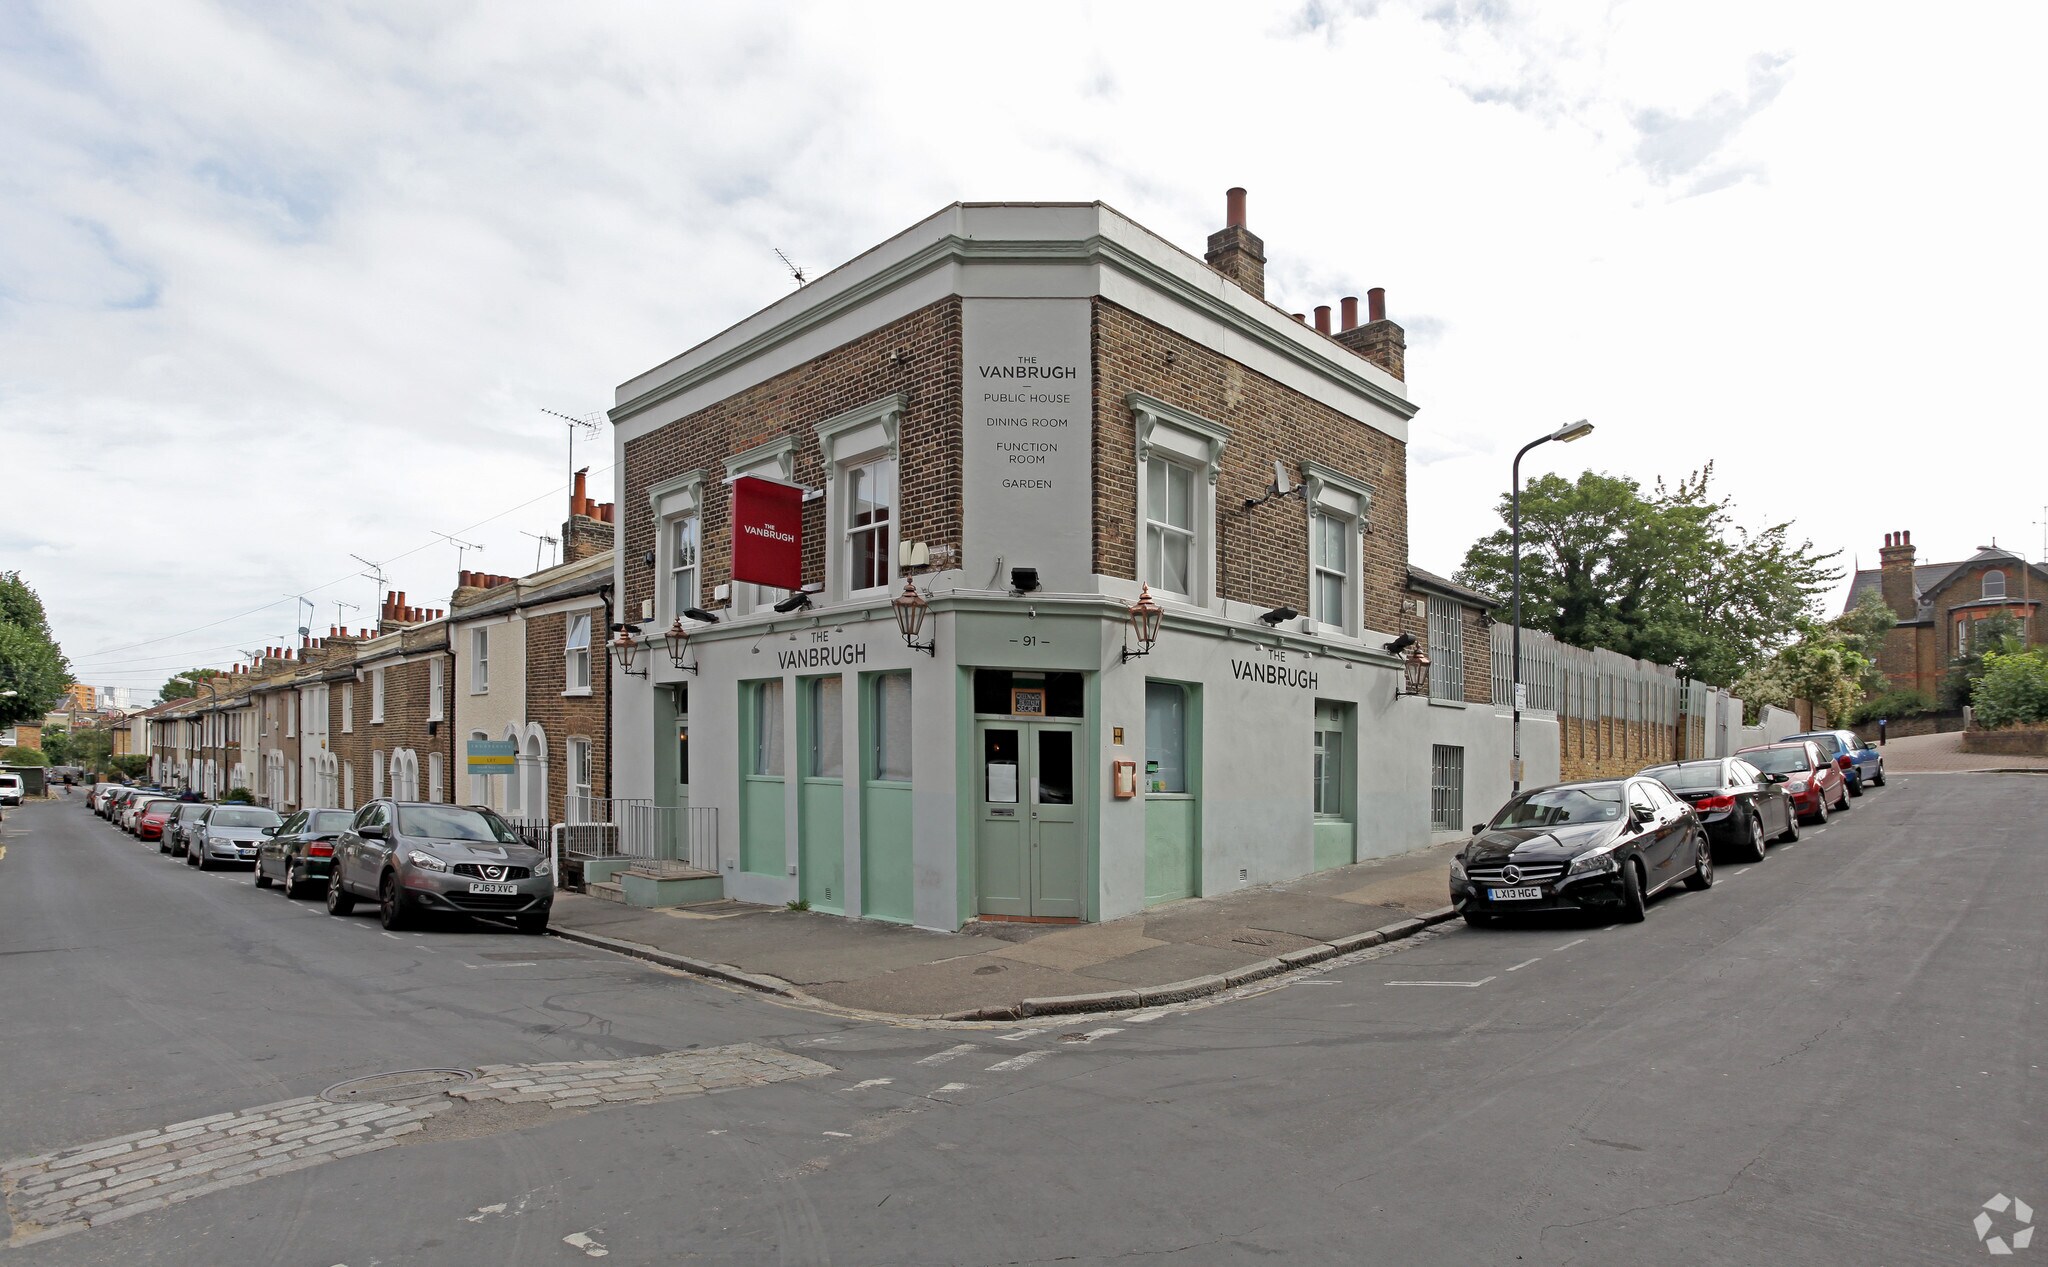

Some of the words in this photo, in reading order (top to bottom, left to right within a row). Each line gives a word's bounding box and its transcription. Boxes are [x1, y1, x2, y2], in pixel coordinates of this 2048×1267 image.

[1018, 356, 1037, 364] THE
[979, 365, 1076, 379] VANBRUGH
[984, 393, 1026, 403] PUBLIC
[1030, 394, 1070, 403] HOUSE
[986, 417, 1028, 427] DINING
[1032, 418, 1068, 427] ROOM
[996, 442, 1058, 452] FUNCTION
[1009, 455, 1045, 464] ROOM
[1002, 479, 1052, 488] GARDEN
[744, 524, 794, 543] VANBRUGH
[811, 630, 829, 643] THE
[778, 643, 866, 670] VANBRUGH
[1268, 649, 1286, 662] THE
[1231, 659, 1318, 690] VANBRUGH
[1016, 704, 1040, 713] SECRET
[473, 883, 496, 892] PJ63
[497, 884, 514, 893] XVC
[1495, 889, 1516, 898] LX13
[1517, 888, 1538, 897] HGC
